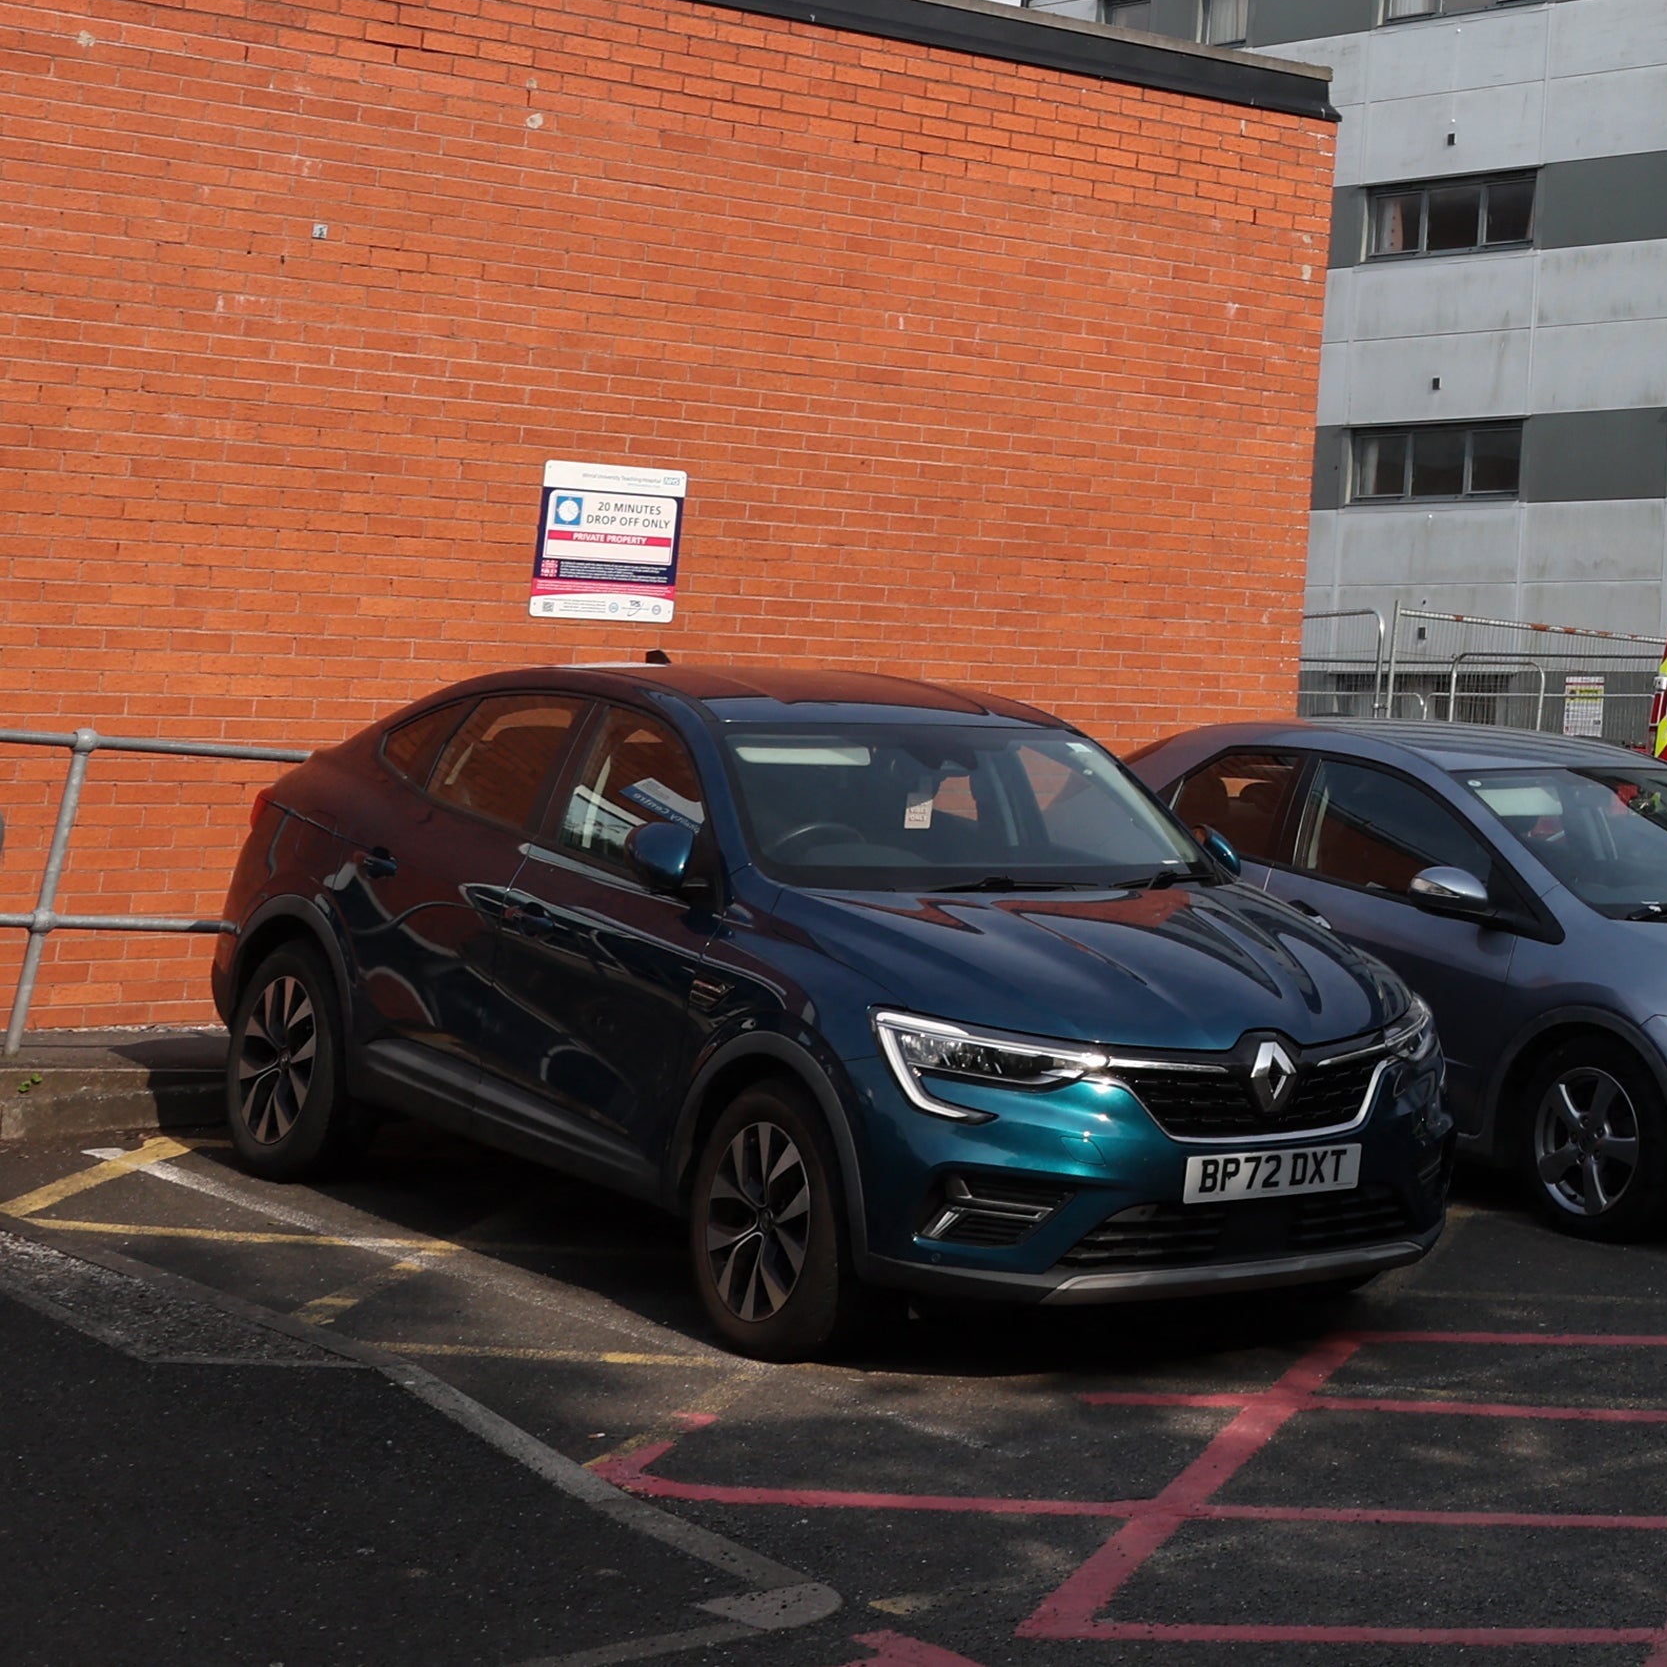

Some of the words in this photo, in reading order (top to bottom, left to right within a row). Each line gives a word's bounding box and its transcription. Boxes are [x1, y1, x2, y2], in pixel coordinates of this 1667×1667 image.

[598, 502, 610, 511] 20
[614, 503, 662, 516] MINUTES
[586, 514, 616, 525] DROP
[619, 516, 640, 526] OFF
[642, 518, 670, 529] ONLY
[572, 532, 605, 542] PRIVATE
[606, 535, 648, 544] PROPERTY
[1198, 1155, 1282, 1193] BP72
[1289, 1149, 1347, 1186] DXT
